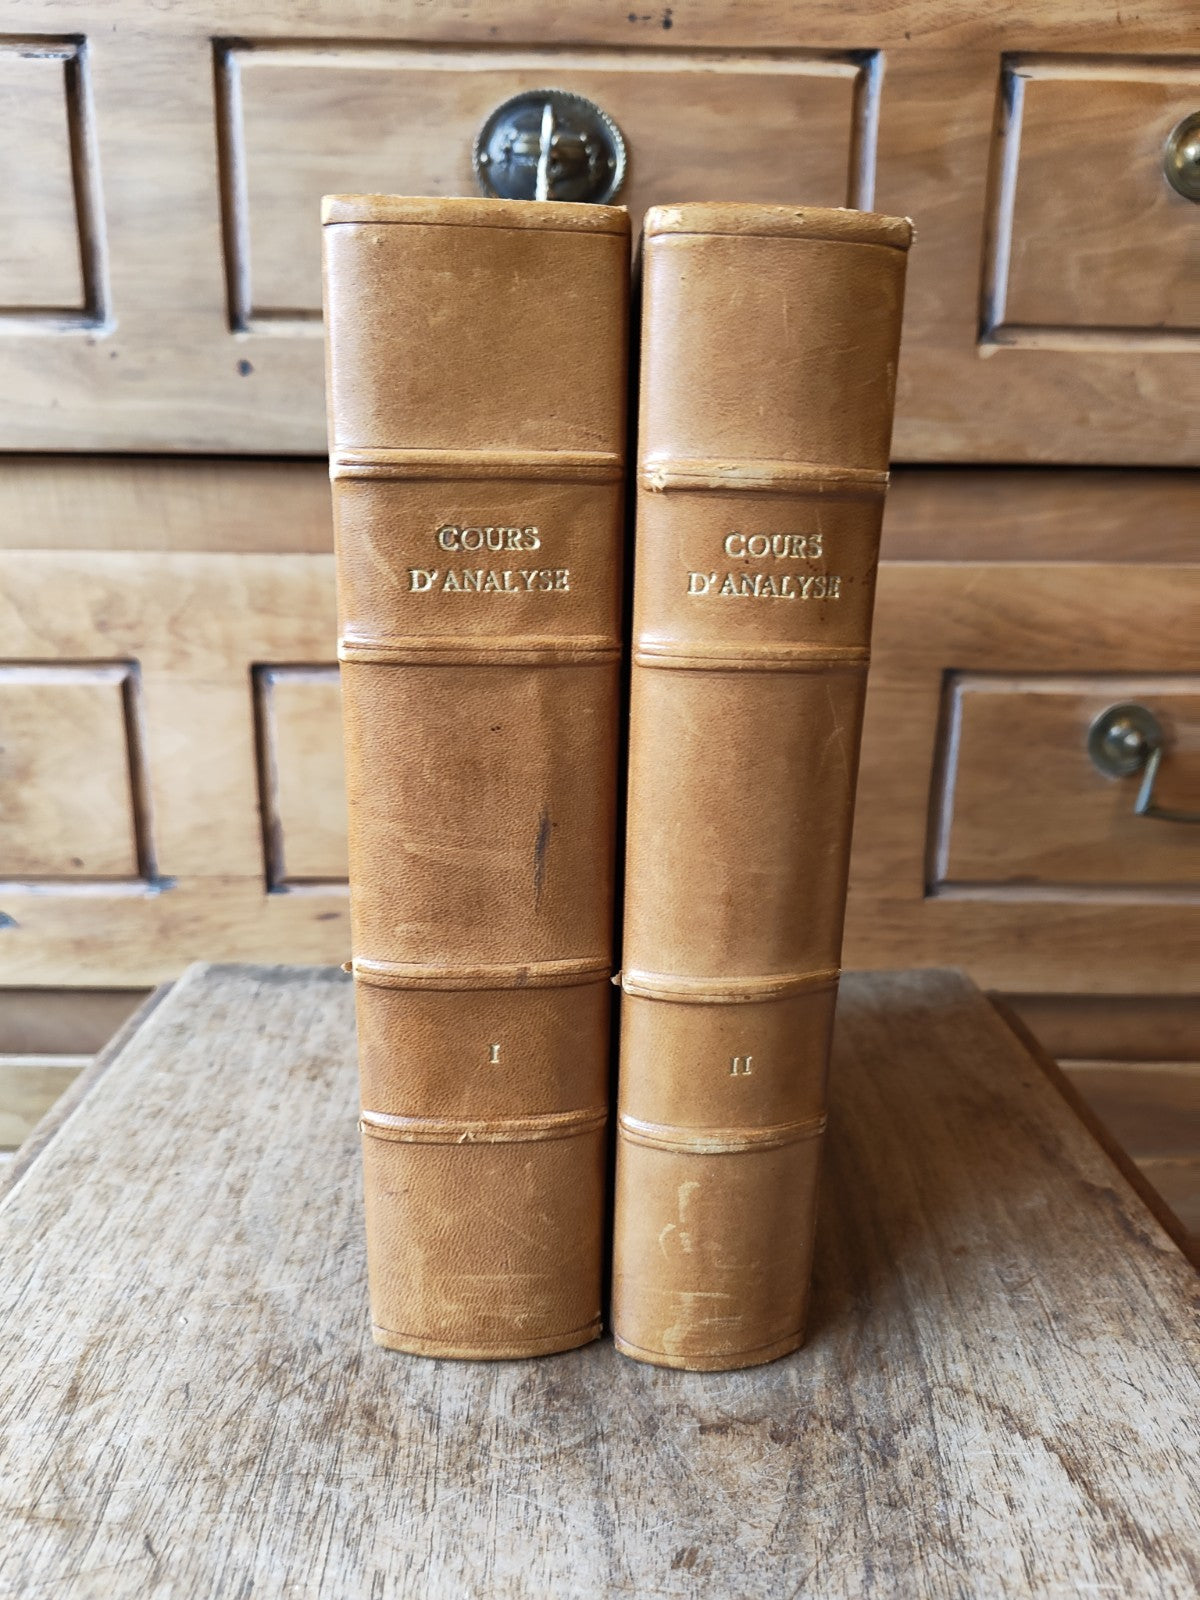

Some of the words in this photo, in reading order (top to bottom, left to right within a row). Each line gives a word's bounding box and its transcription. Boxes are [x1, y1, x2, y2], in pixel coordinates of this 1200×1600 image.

[437, 526, 541, 551] COURS
[724, 533, 823, 559] COURS
[408, 568, 570, 593] D'ANALYSE
[687, 571, 841, 600] D'ANALYSE
[489, 1044, 501, 1064] I
[729, 1056, 753, 1077] II
